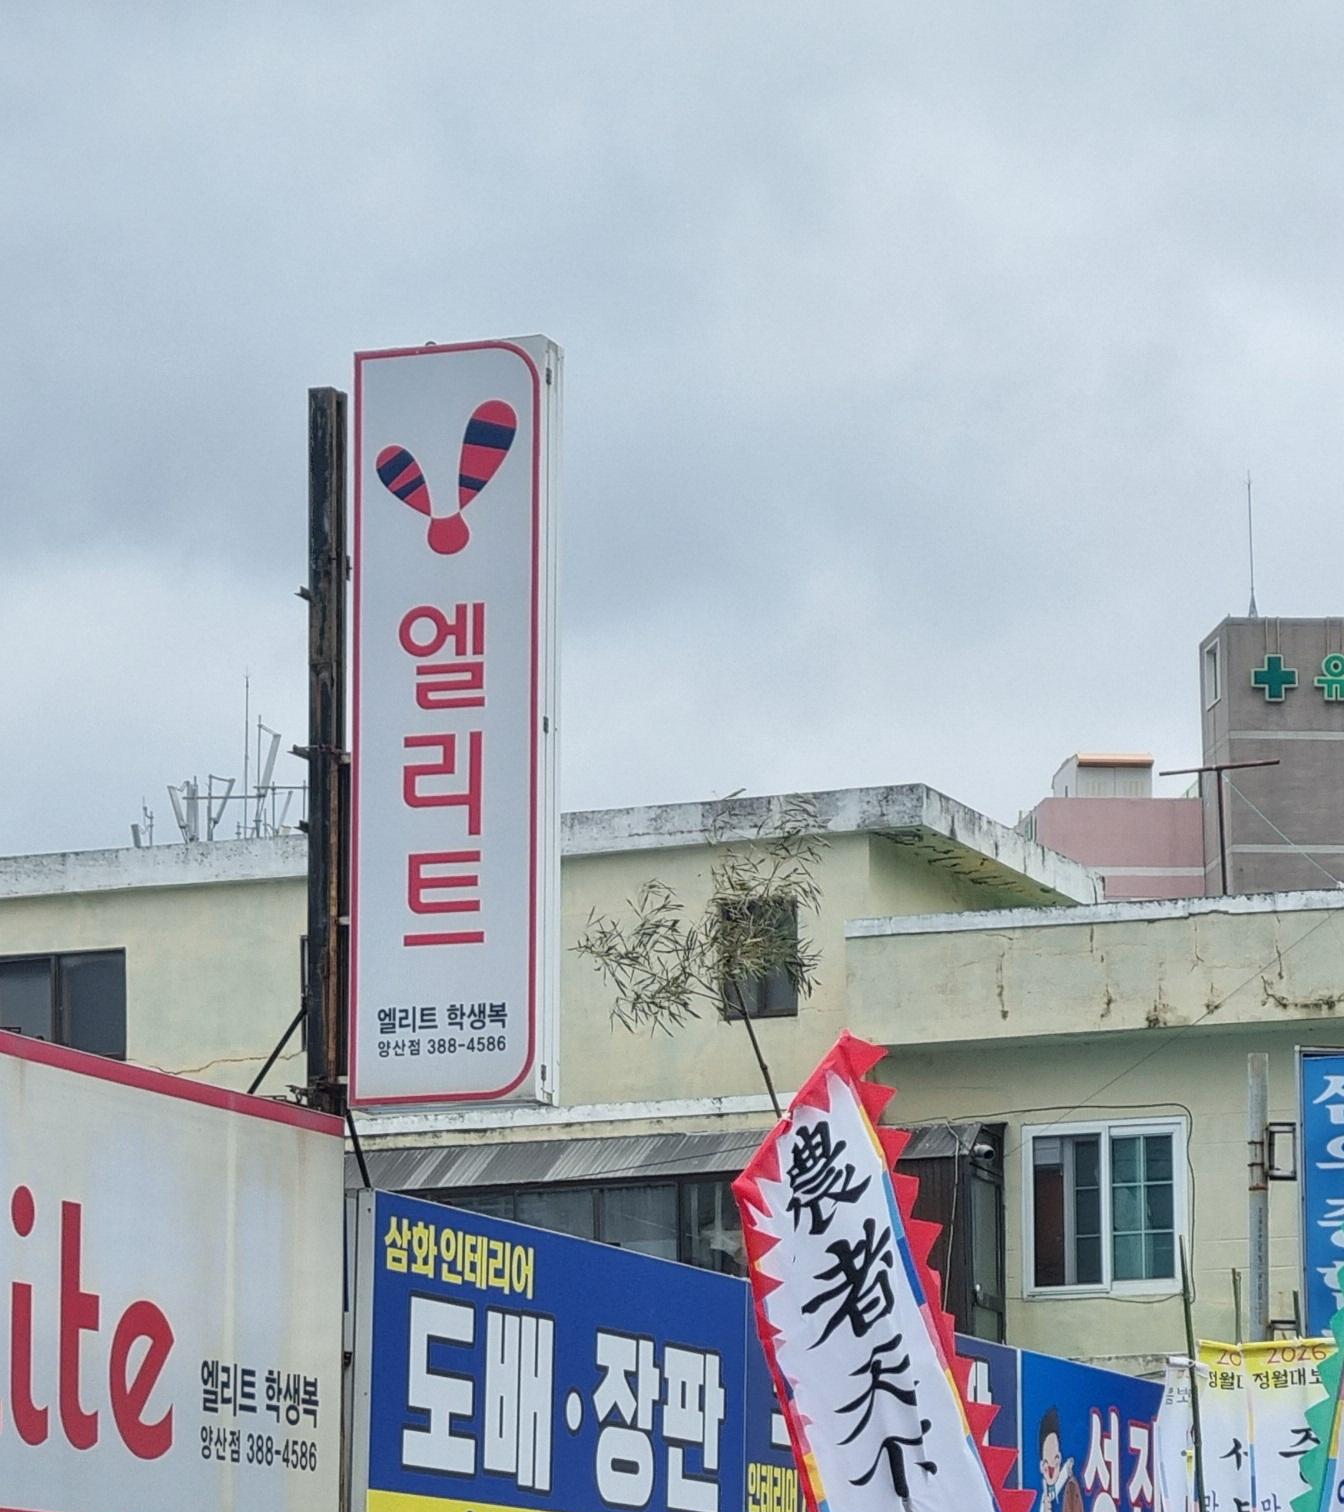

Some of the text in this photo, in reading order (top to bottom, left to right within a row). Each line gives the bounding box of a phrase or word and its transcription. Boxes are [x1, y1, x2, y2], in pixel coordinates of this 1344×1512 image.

[398, 603, 486, 948] 엘리트
[376, 1001, 508, 1035] 엘리트 학생복
[377, 1034, 507, 1059] 양산점 388-4586
[199, 1357, 321, 1429] 엘리트 학생복
[1252, 1367, 1323, 1390] 정월대보
[199, 1431, 318, 1473] 양산점 388-4586
